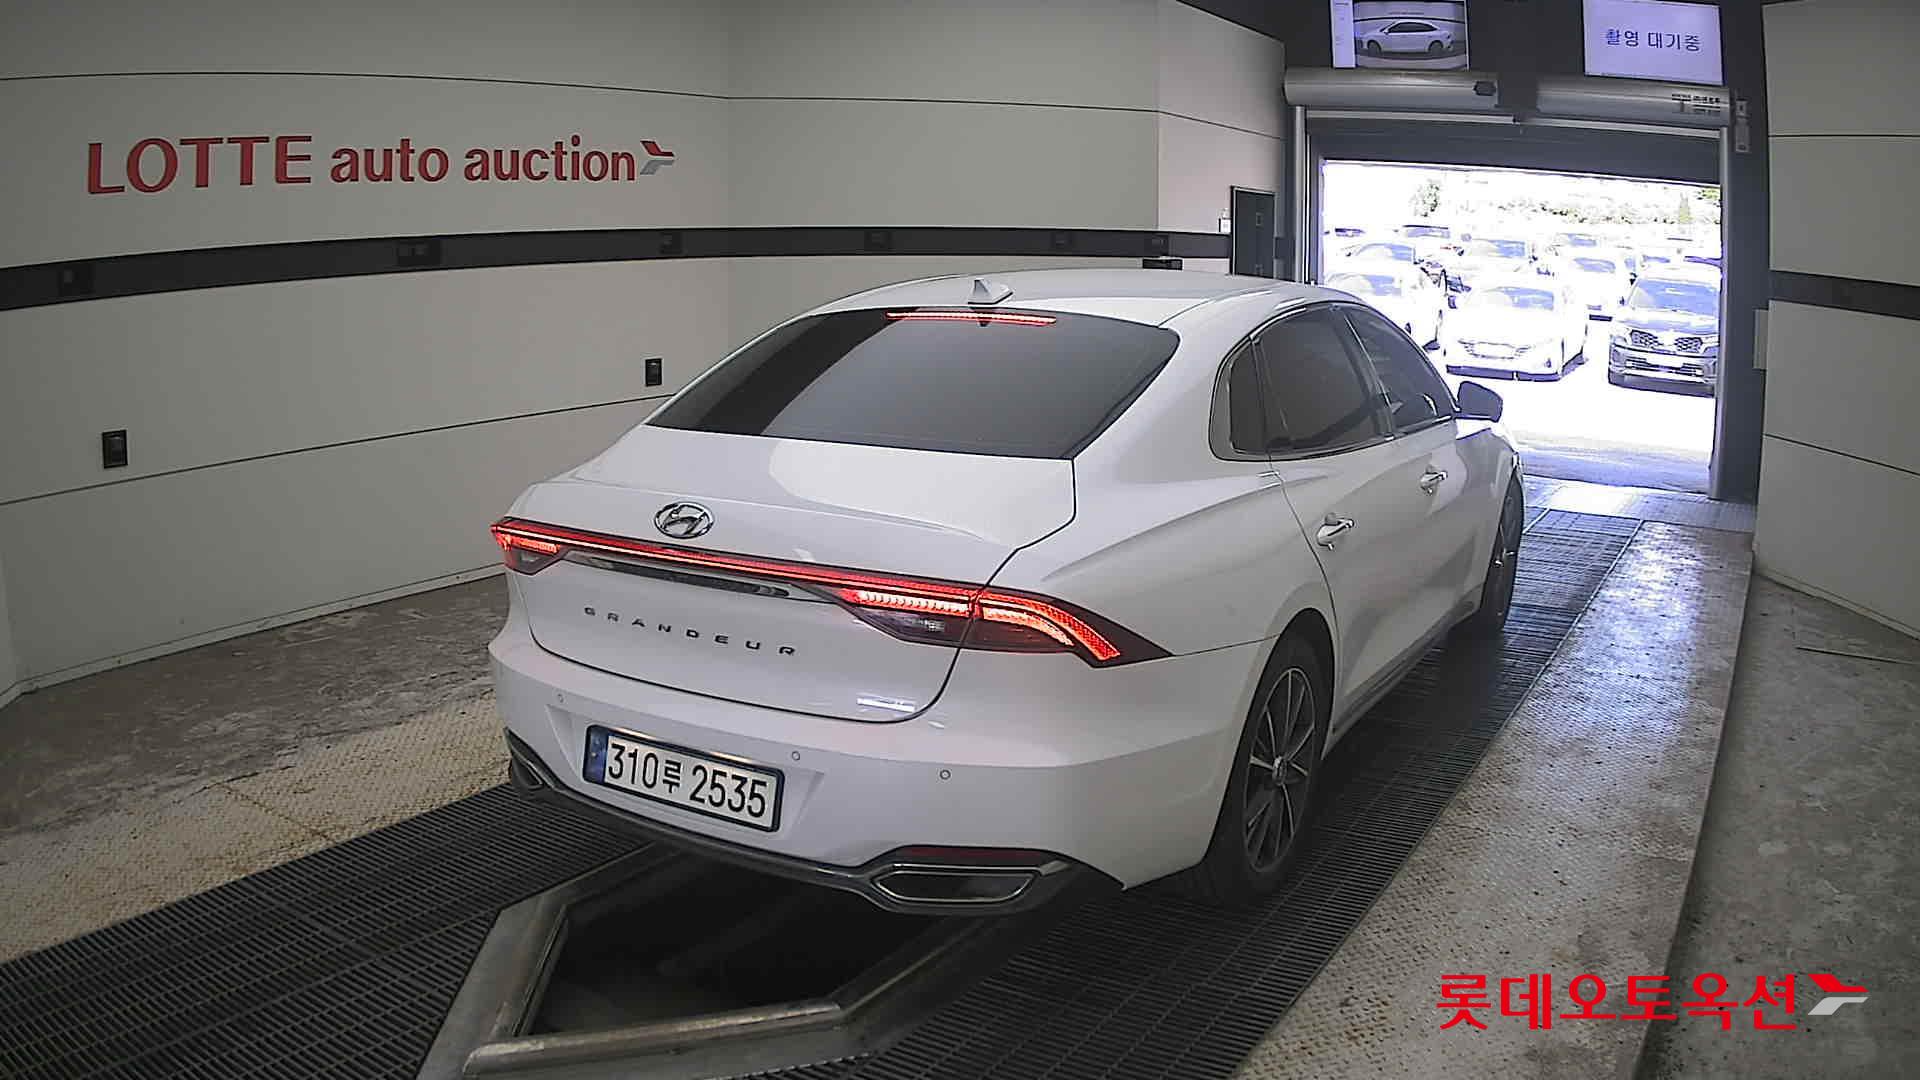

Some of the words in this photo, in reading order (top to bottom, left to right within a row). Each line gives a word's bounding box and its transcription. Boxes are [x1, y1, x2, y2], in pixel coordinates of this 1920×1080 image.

[1647, 31, 1701, 52] 대기중
[87, 135, 313, 195] LOTTE
[330, 138, 450, 184] auto
[463, 135, 637, 183] auction
[583, 606, 797, 656] GRANDEUR
[607, 742, 683, 794] 310루
[689, 764, 768, 818] 2535
